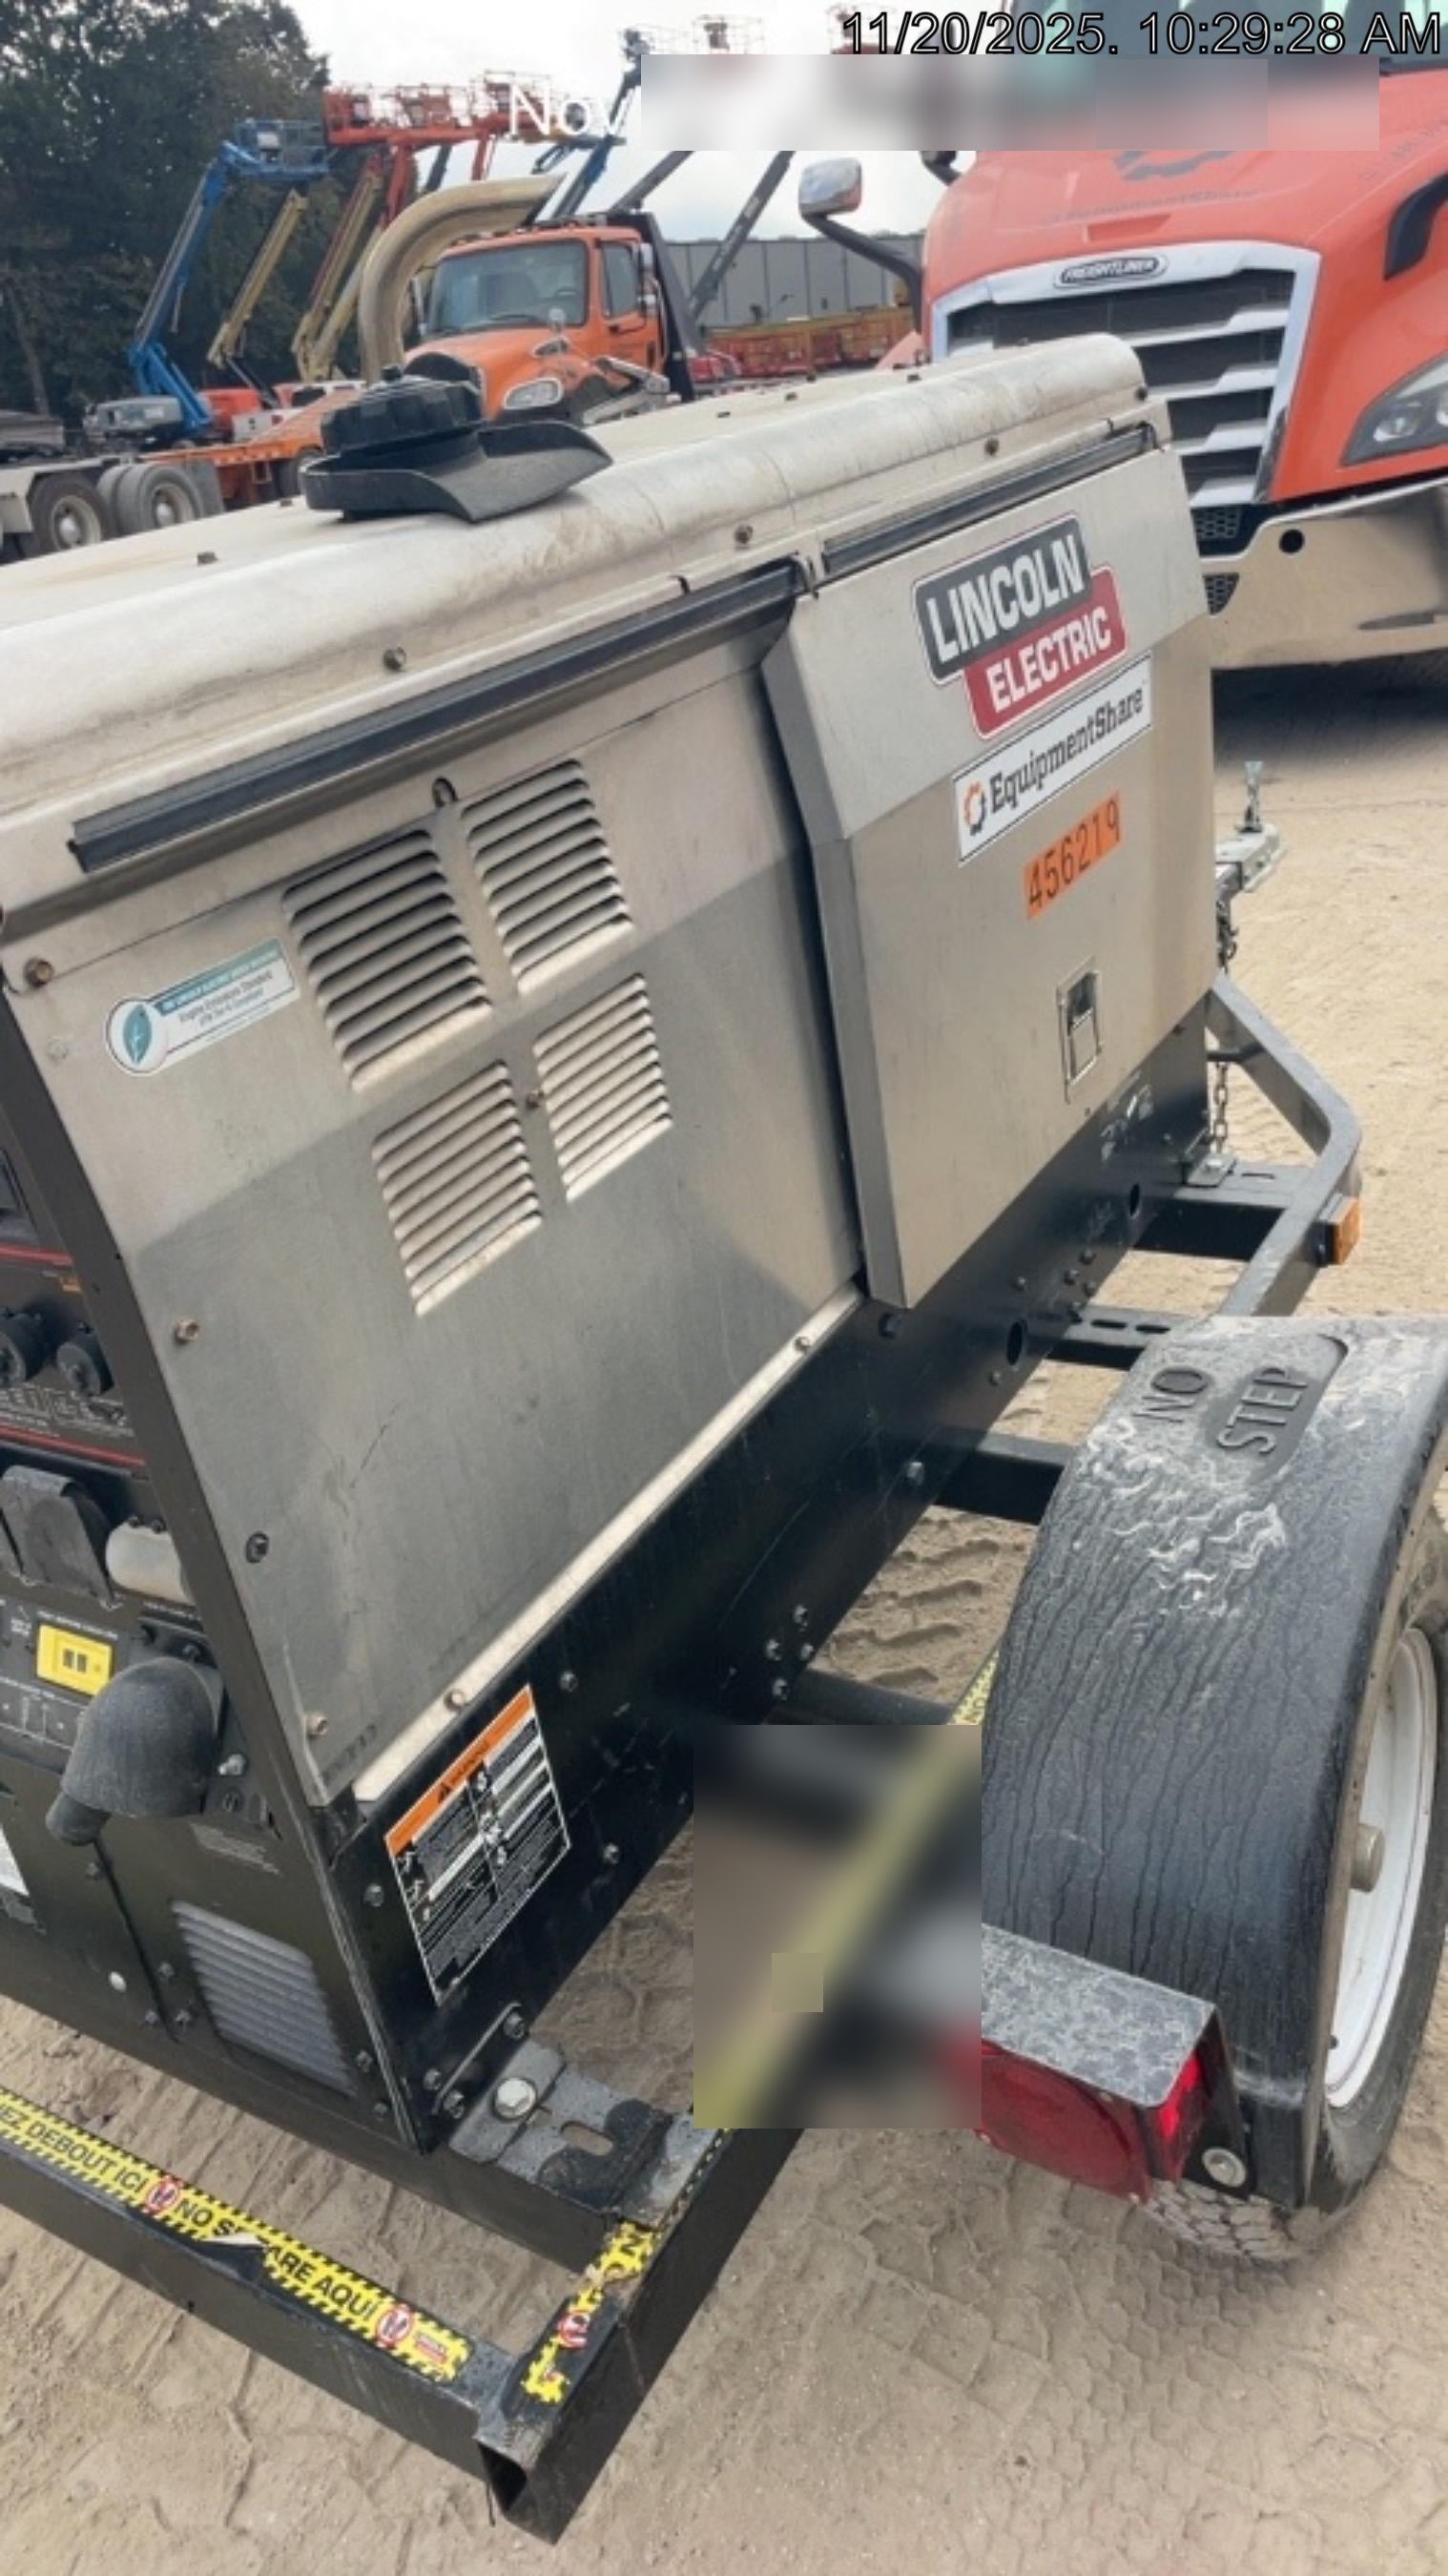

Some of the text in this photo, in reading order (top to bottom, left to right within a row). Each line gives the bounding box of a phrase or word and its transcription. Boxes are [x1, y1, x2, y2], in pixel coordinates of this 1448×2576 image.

[927, 533, 1086, 663] LINCOLN
[985, 604, 1113, 715] ELECTRIC
[989, 685, 1145, 814] EquipmentShare
[1028, 798, 1122, 910] 456219
[1131, 1366, 1209, 1423] NO
[1216, 1366, 1309, 1455] STEP
[26, 2119, 117, 2176] DEBOUT
[114, 2166, 150, 2194] ICI
[174, 2197, 213, 2228] NO
